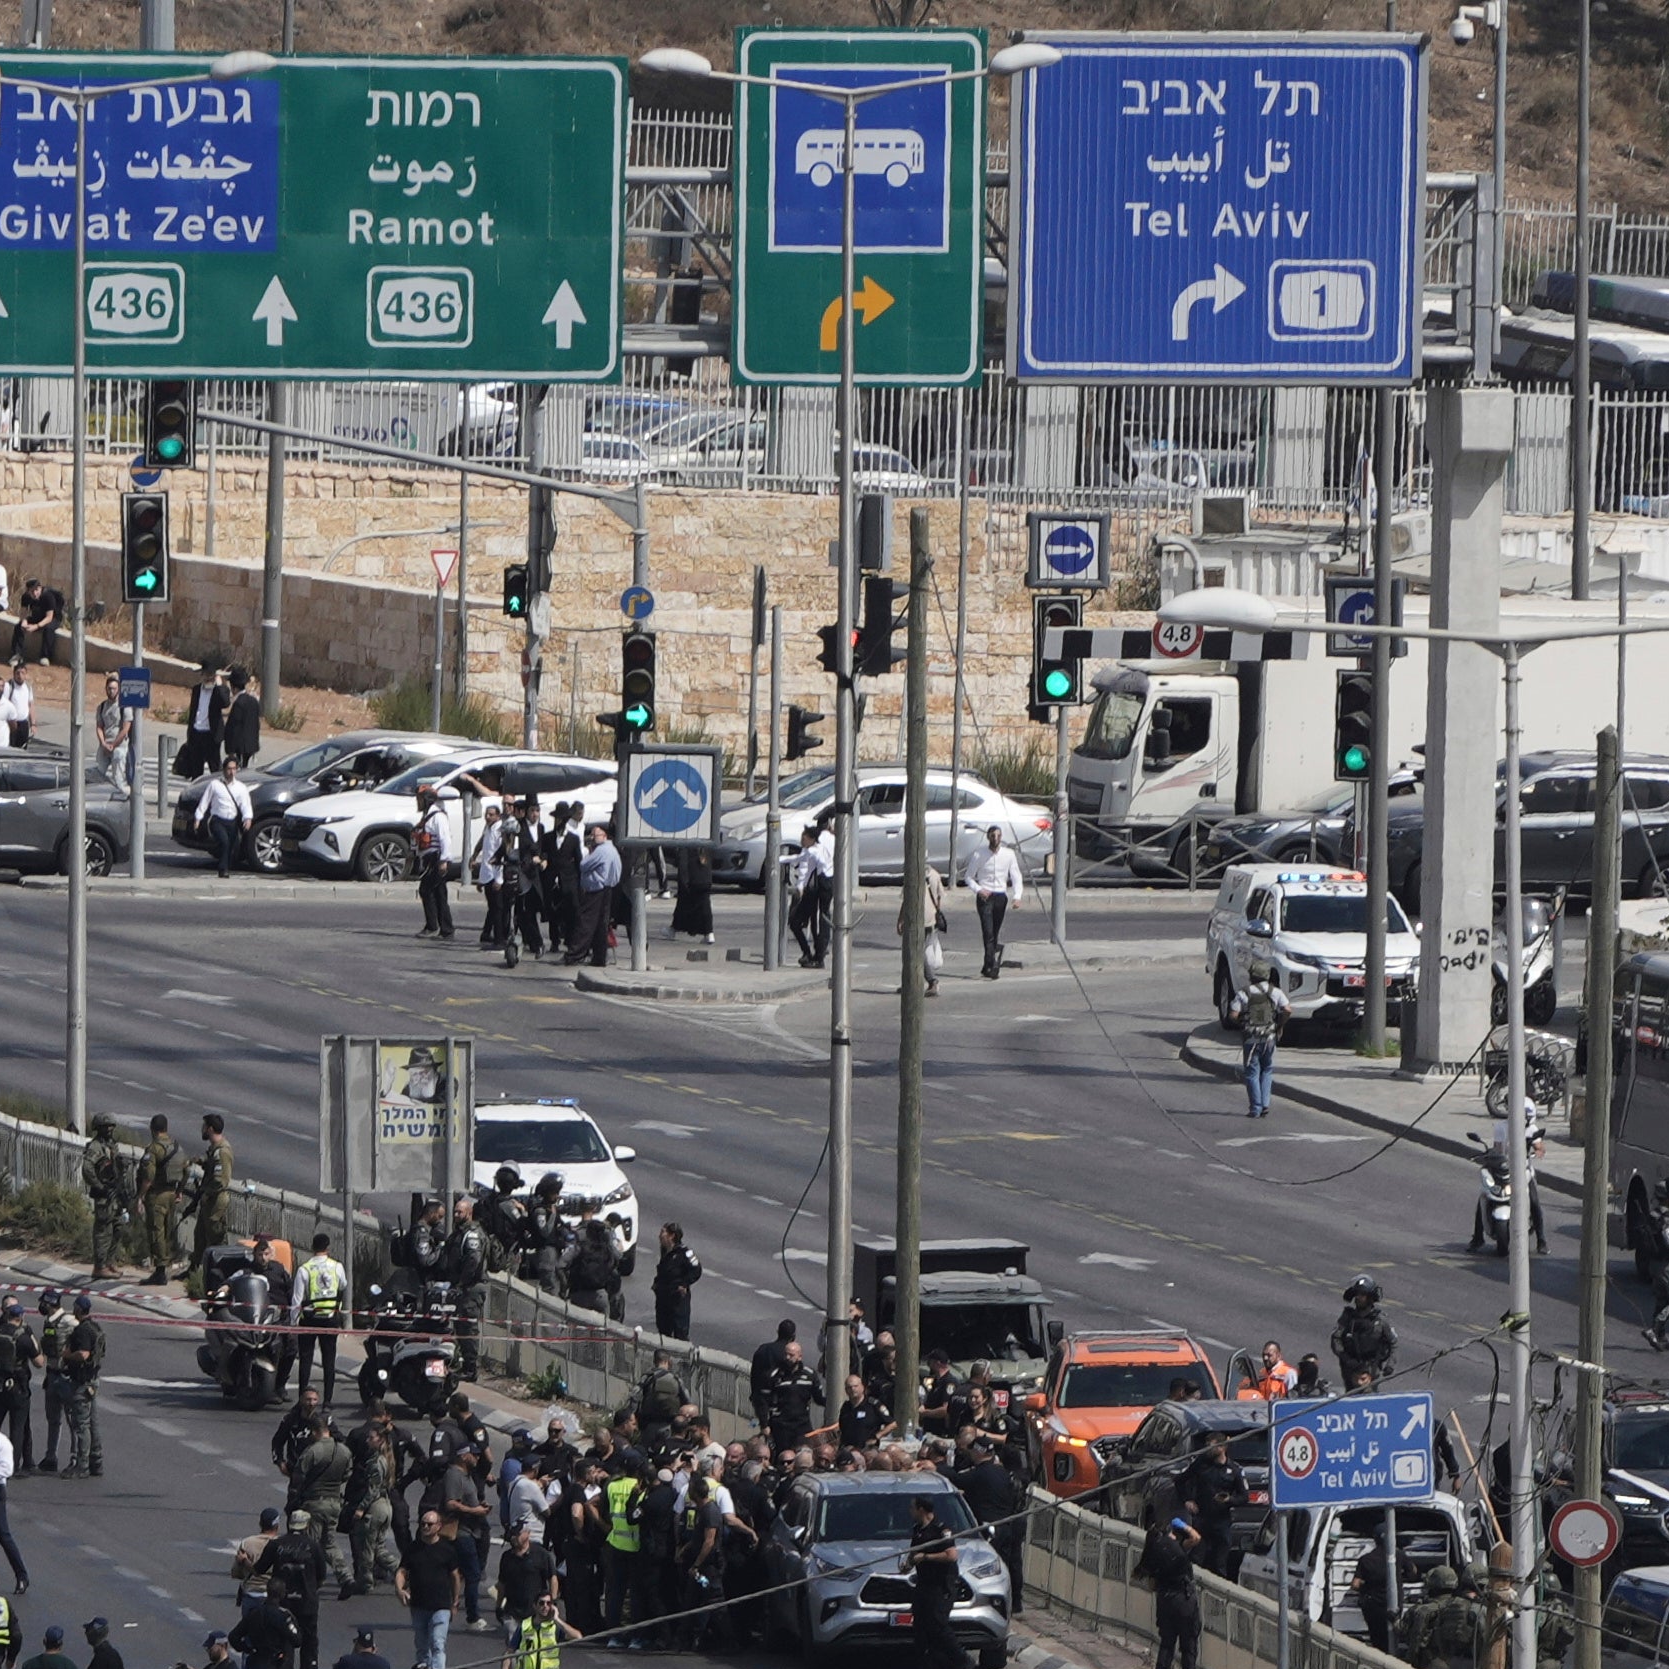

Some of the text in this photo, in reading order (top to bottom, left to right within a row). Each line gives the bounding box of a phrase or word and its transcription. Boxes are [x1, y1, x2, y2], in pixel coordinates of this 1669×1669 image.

[127, 85, 252, 127] גבעת
[365, 90, 481, 128] רמות
[1122, 70, 1320, 116] תל אביב
[1146, 125, 1291, 189] تل أبيب
[153, 207, 265, 243] Ze'ev
[348, 209, 494, 245] Ramot
[1125, 202, 1309, 238] Tel Aviv
[94, 287, 167, 320] 436
[384, 291, 456, 323] 436
[1312, 283, 1327, 317] 1
[1316, 1408, 1389, 1434] תל אביב
[1286, 1445, 1309, 1463] 4.8
[1405, 1462, 1414, 1479] 1
[1318, 1468, 1387, 1489] Tel Aviv
